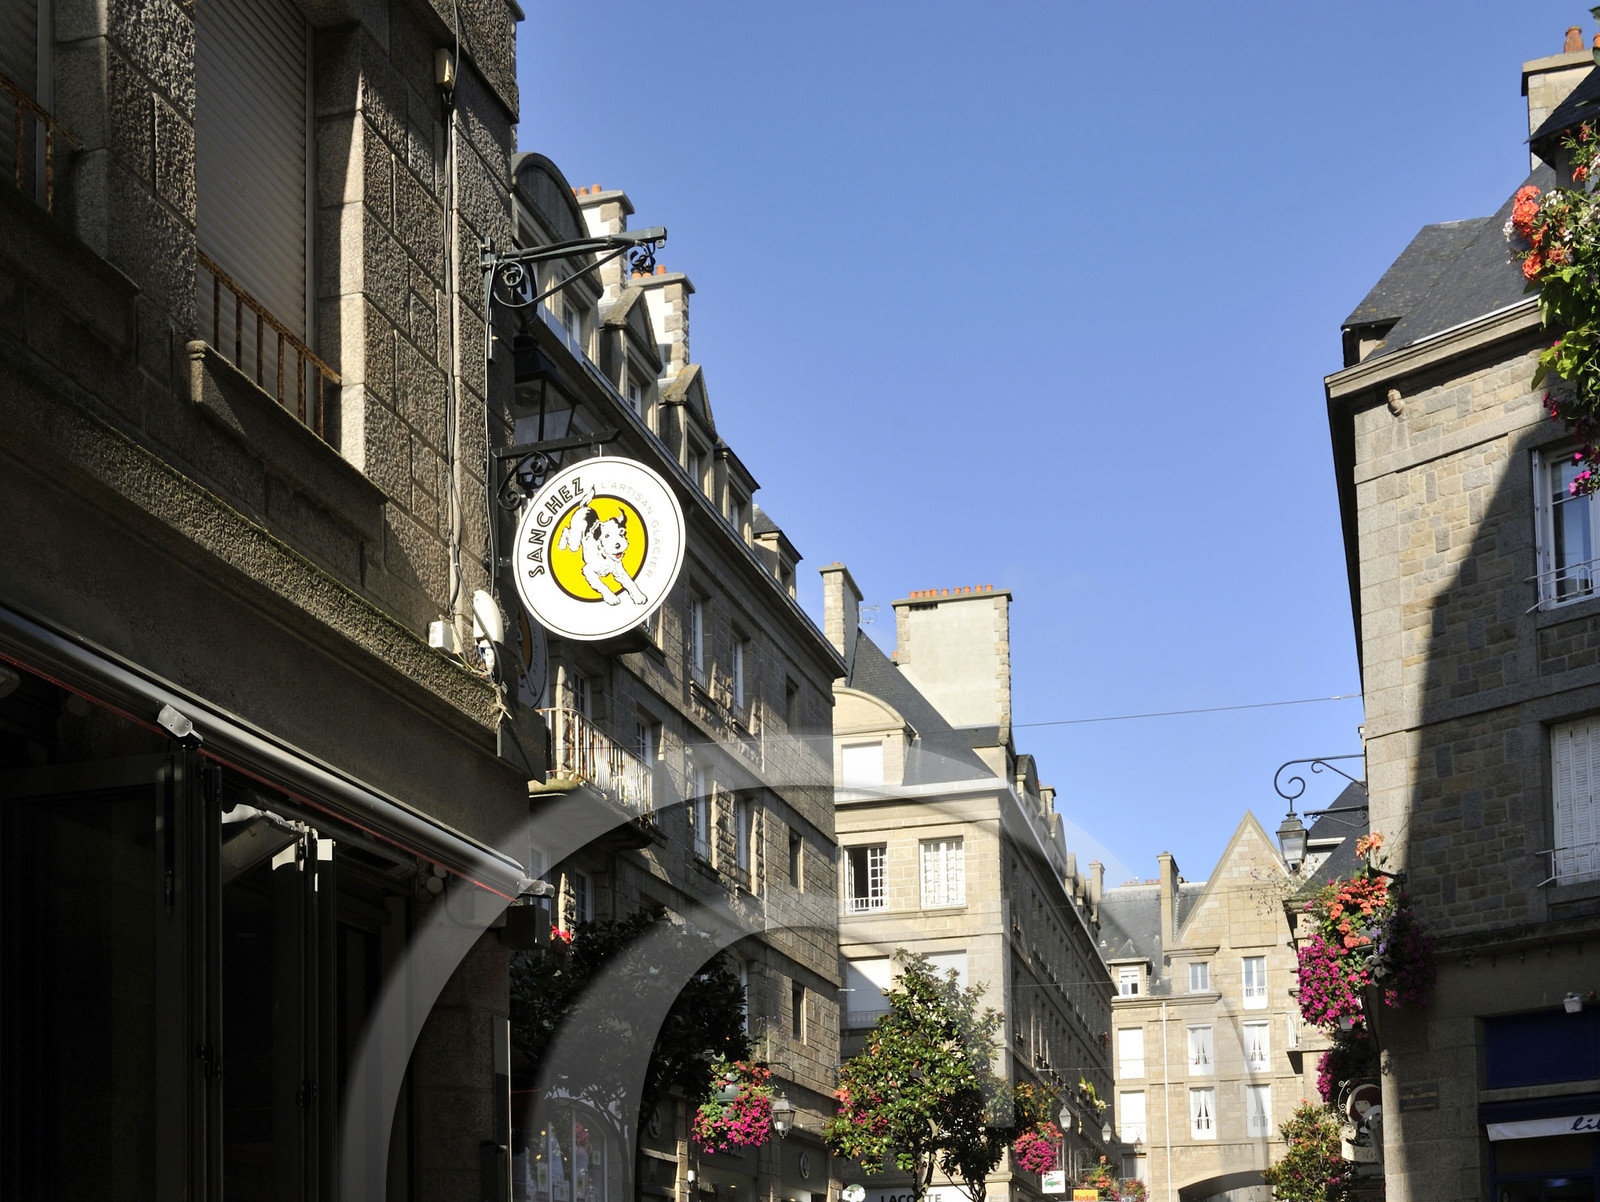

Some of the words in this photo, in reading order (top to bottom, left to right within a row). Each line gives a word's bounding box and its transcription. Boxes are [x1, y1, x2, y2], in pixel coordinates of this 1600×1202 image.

[527, 476, 584, 578] SANCHEZ
[600, 481, 654, 515] L'ARTISAN
[644, 519, 661, 578] GLACIER
[1571, 1115, 1600, 1131] li
